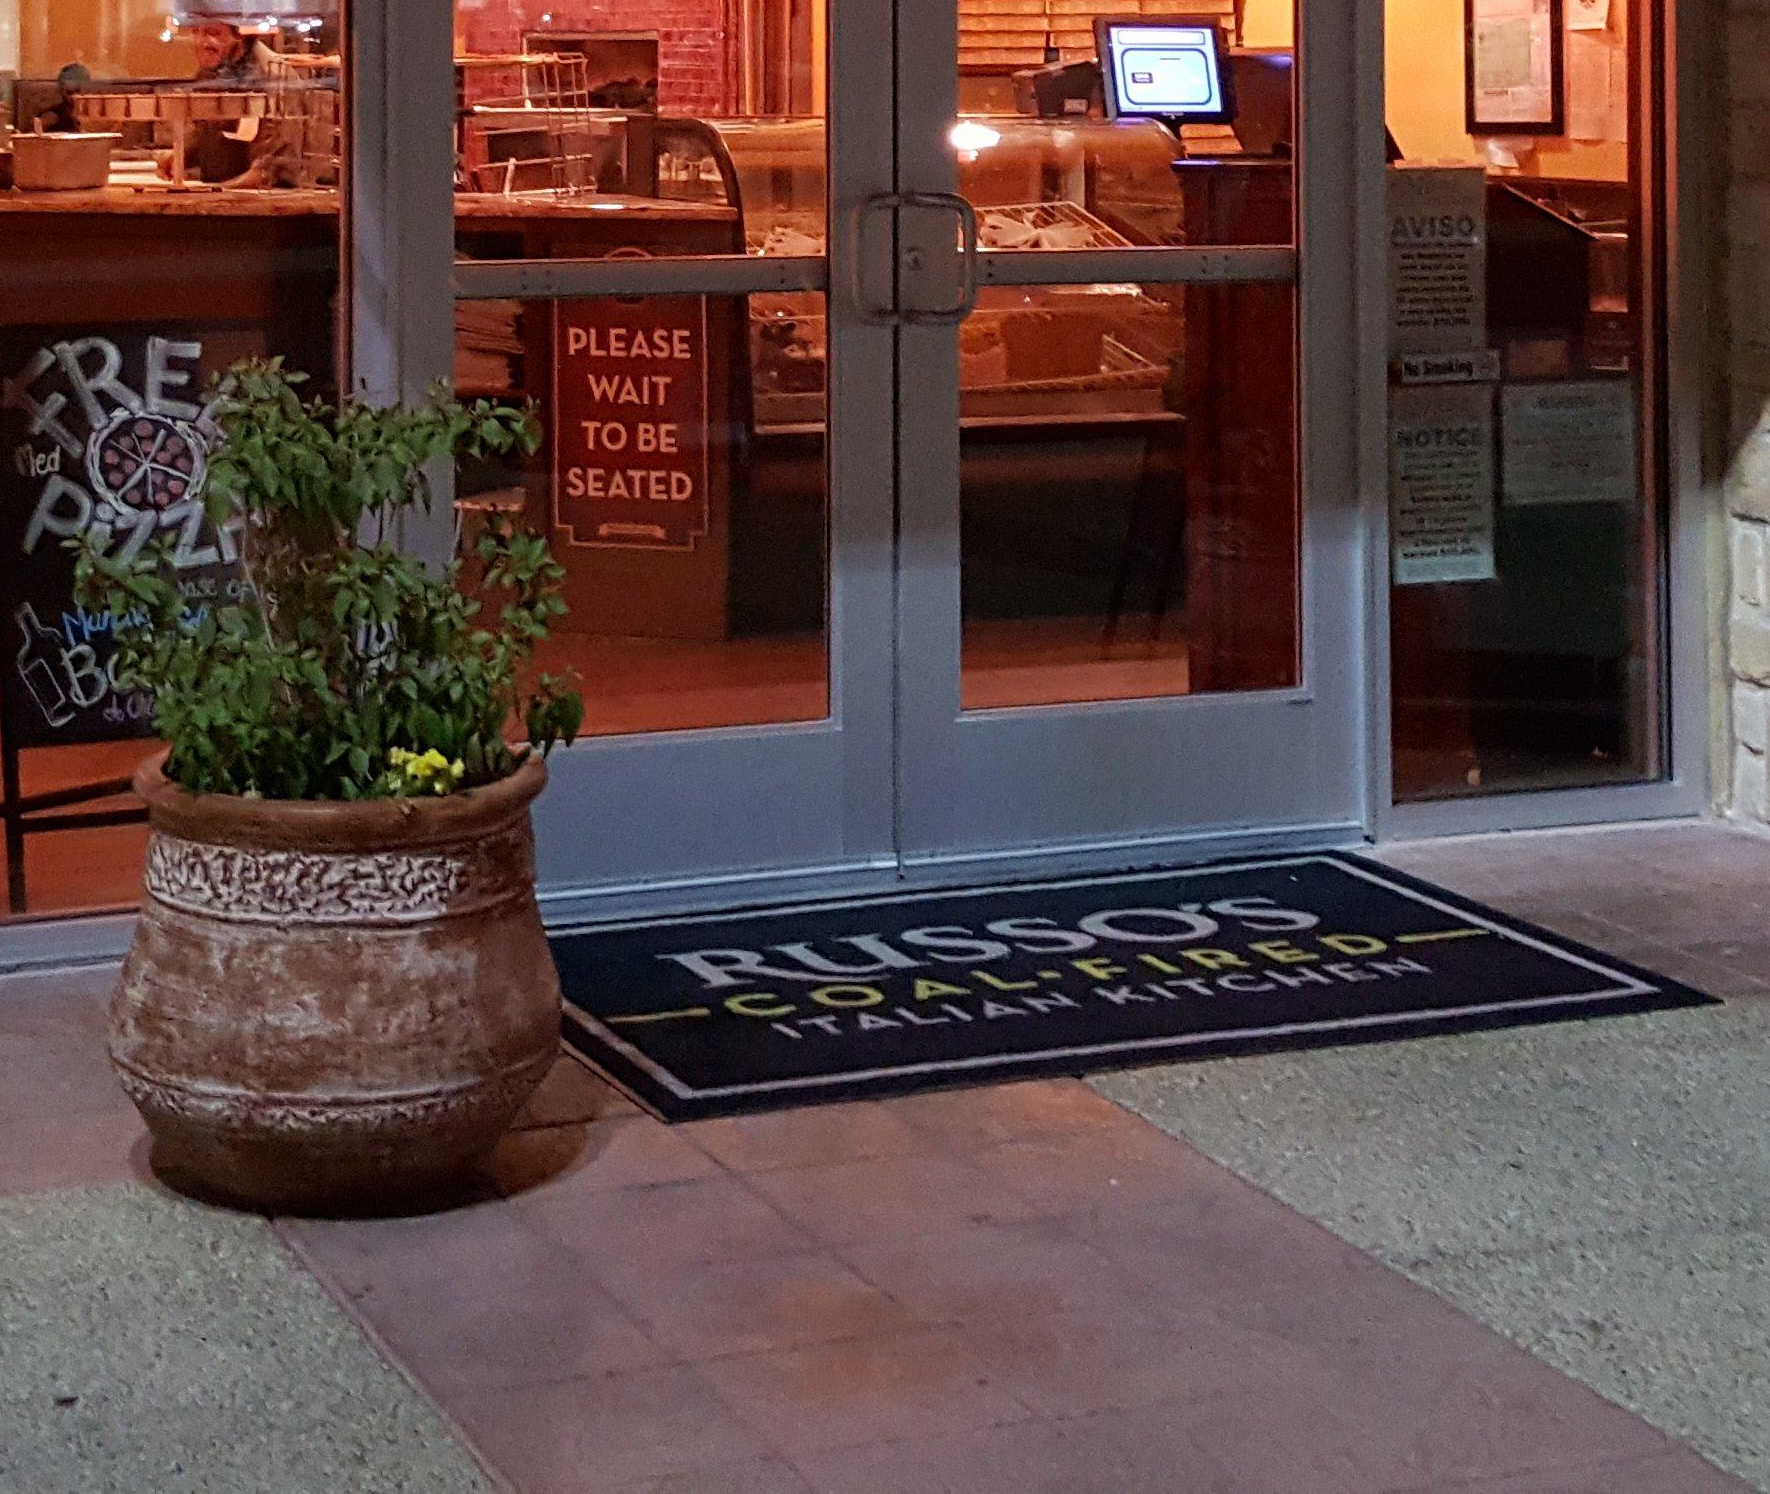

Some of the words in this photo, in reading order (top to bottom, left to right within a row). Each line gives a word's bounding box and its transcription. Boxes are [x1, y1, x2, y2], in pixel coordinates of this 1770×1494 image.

[1392, 216, 1474, 238] AVISO
[567, 326, 691, 359] PLEASE
[587, 373, 672, 406] WAIT
[581, 421, 627, 451] TO
[637, 422, 679, 453] BE
[566, 467, 694, 501] SEATED
[657, 897, 1321, 989] RUSSO'S
[770, 990, 1082, 1040] ITALIAN
[1096, 955, 1432, 1004] KITCHEN
